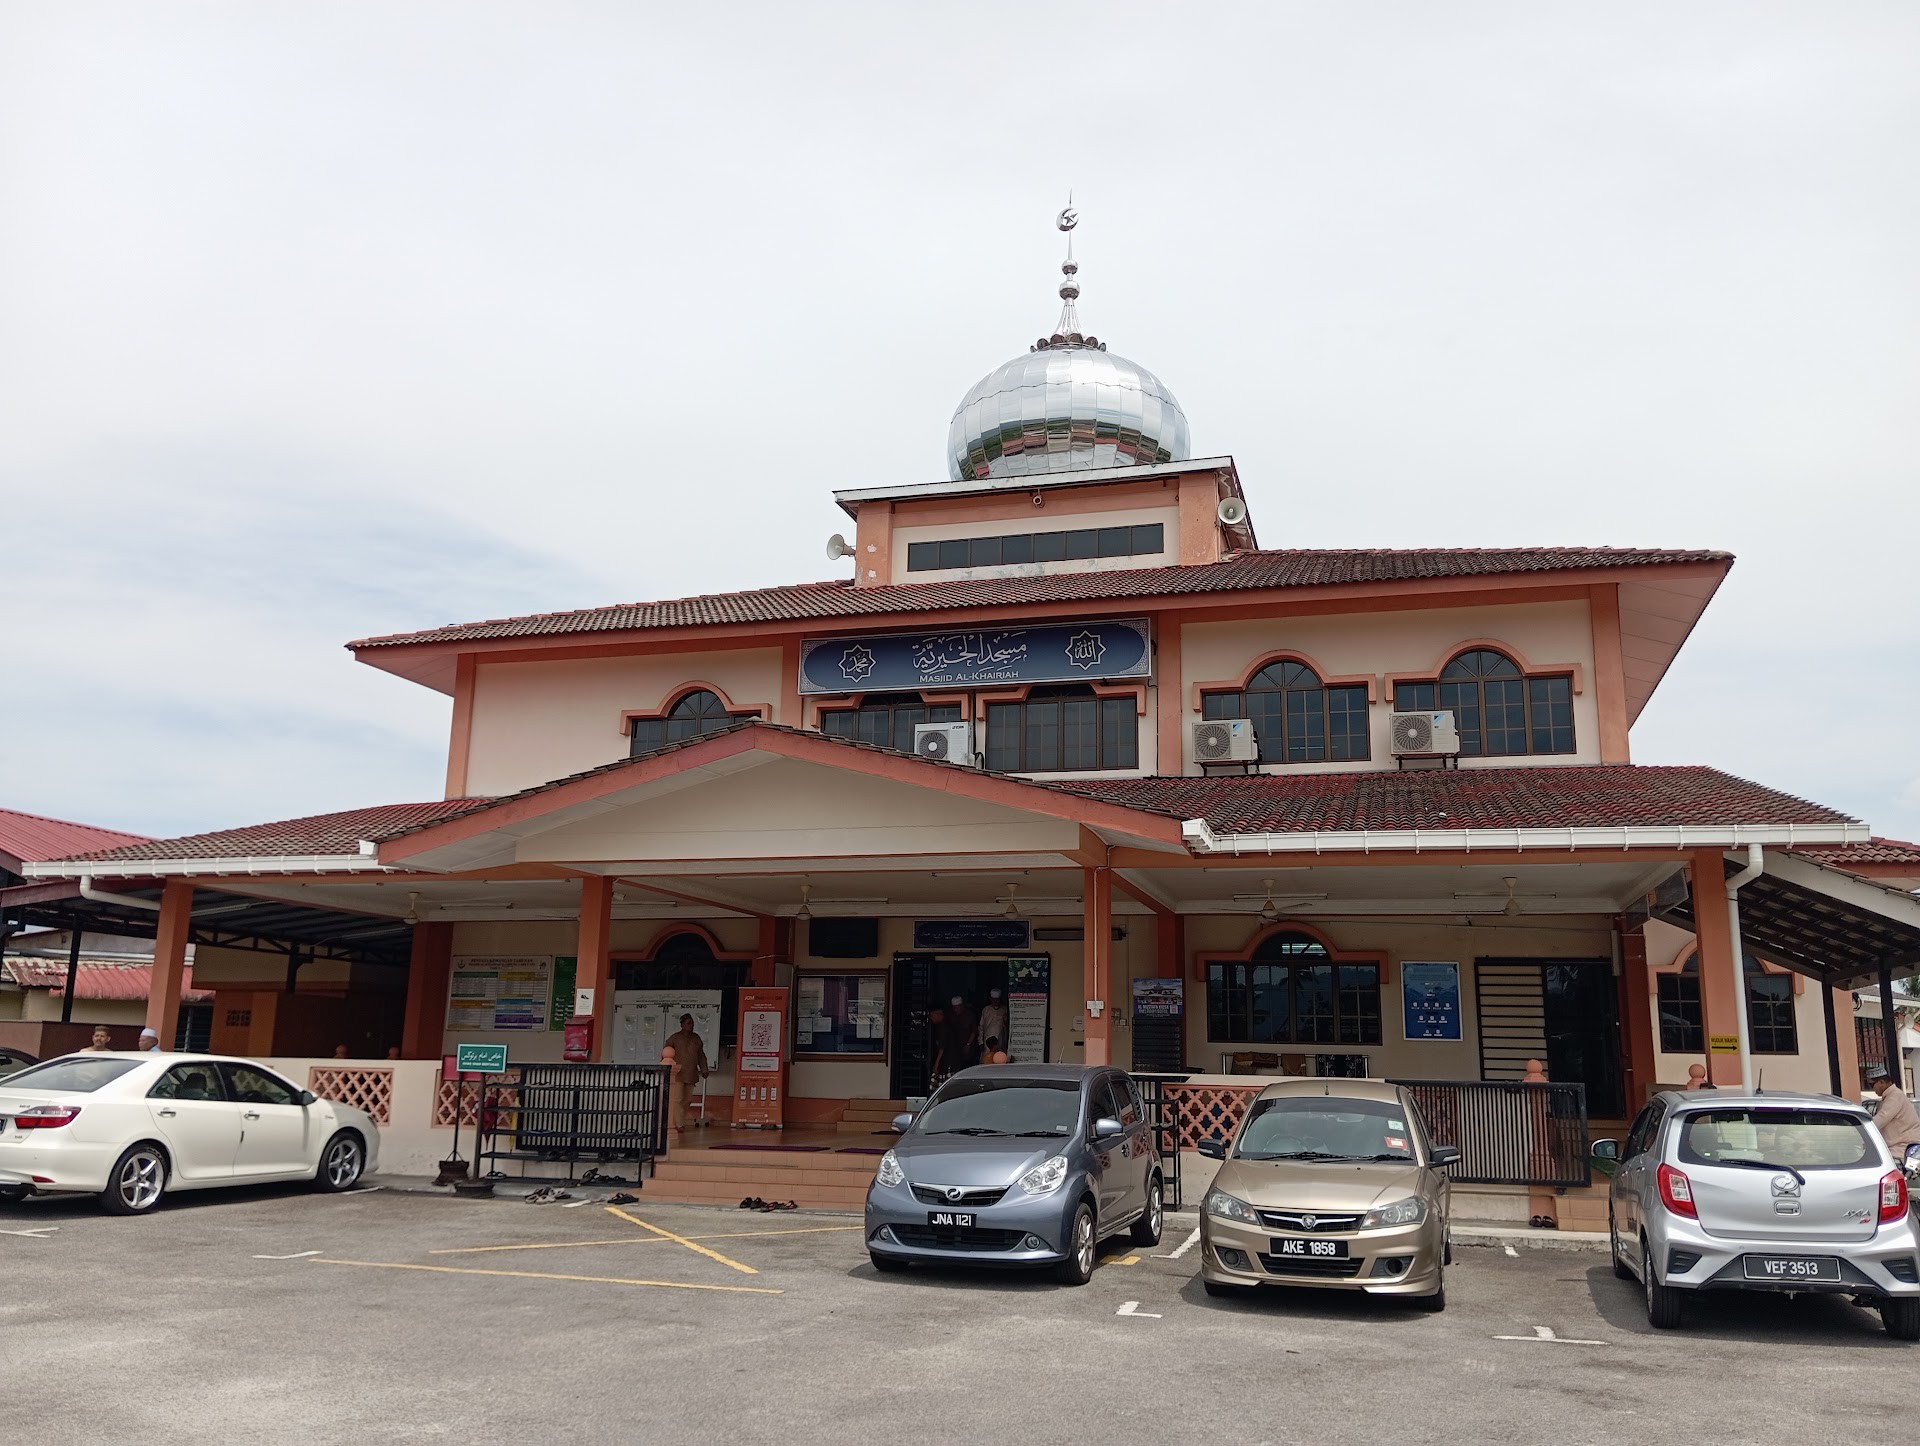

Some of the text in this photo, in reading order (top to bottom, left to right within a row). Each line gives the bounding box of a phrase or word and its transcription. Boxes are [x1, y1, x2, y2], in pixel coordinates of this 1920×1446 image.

[1074, 639, 1096, 660] الله
[919, 671, 1019, 683] MASJID AL-KHAIRIAH
[932, 1213, 971, 1227] JNA 1121
[1282, 1239, 1336, 1256] AKE 1858
[1764, 1260, 1819, 1275] VEF 3513
